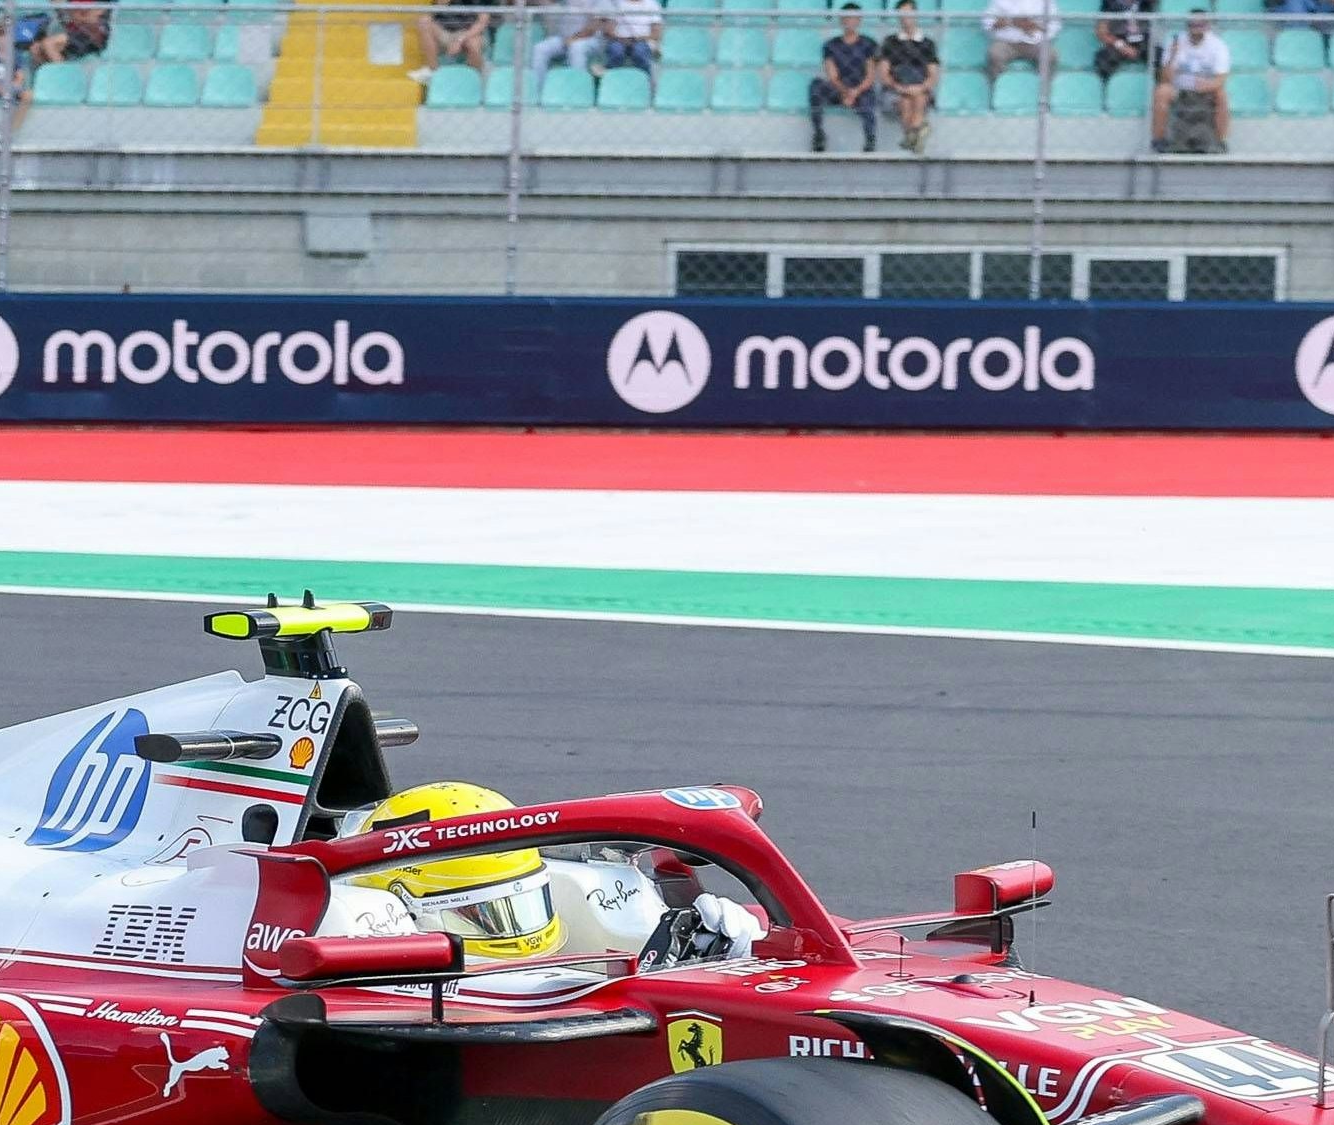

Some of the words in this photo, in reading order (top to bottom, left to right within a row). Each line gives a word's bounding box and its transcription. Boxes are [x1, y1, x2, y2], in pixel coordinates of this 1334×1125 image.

[42, 320, 405, 385] motorola
[734, 325, 1095, 391] motorola
[268, 695, 331, 735] ZCG
[37, 708, 147, 850] hp
[382, 826, 433, 854] DXC
[435, 811, 561, 840] TECHNOLOGY
[92, 904, 197, 963] IBM
[87, 1001, 180, 1026] Hamilton
[955, 996, 1170, 1032] VGW
[1168, 1045, 1332, 1091] 44
